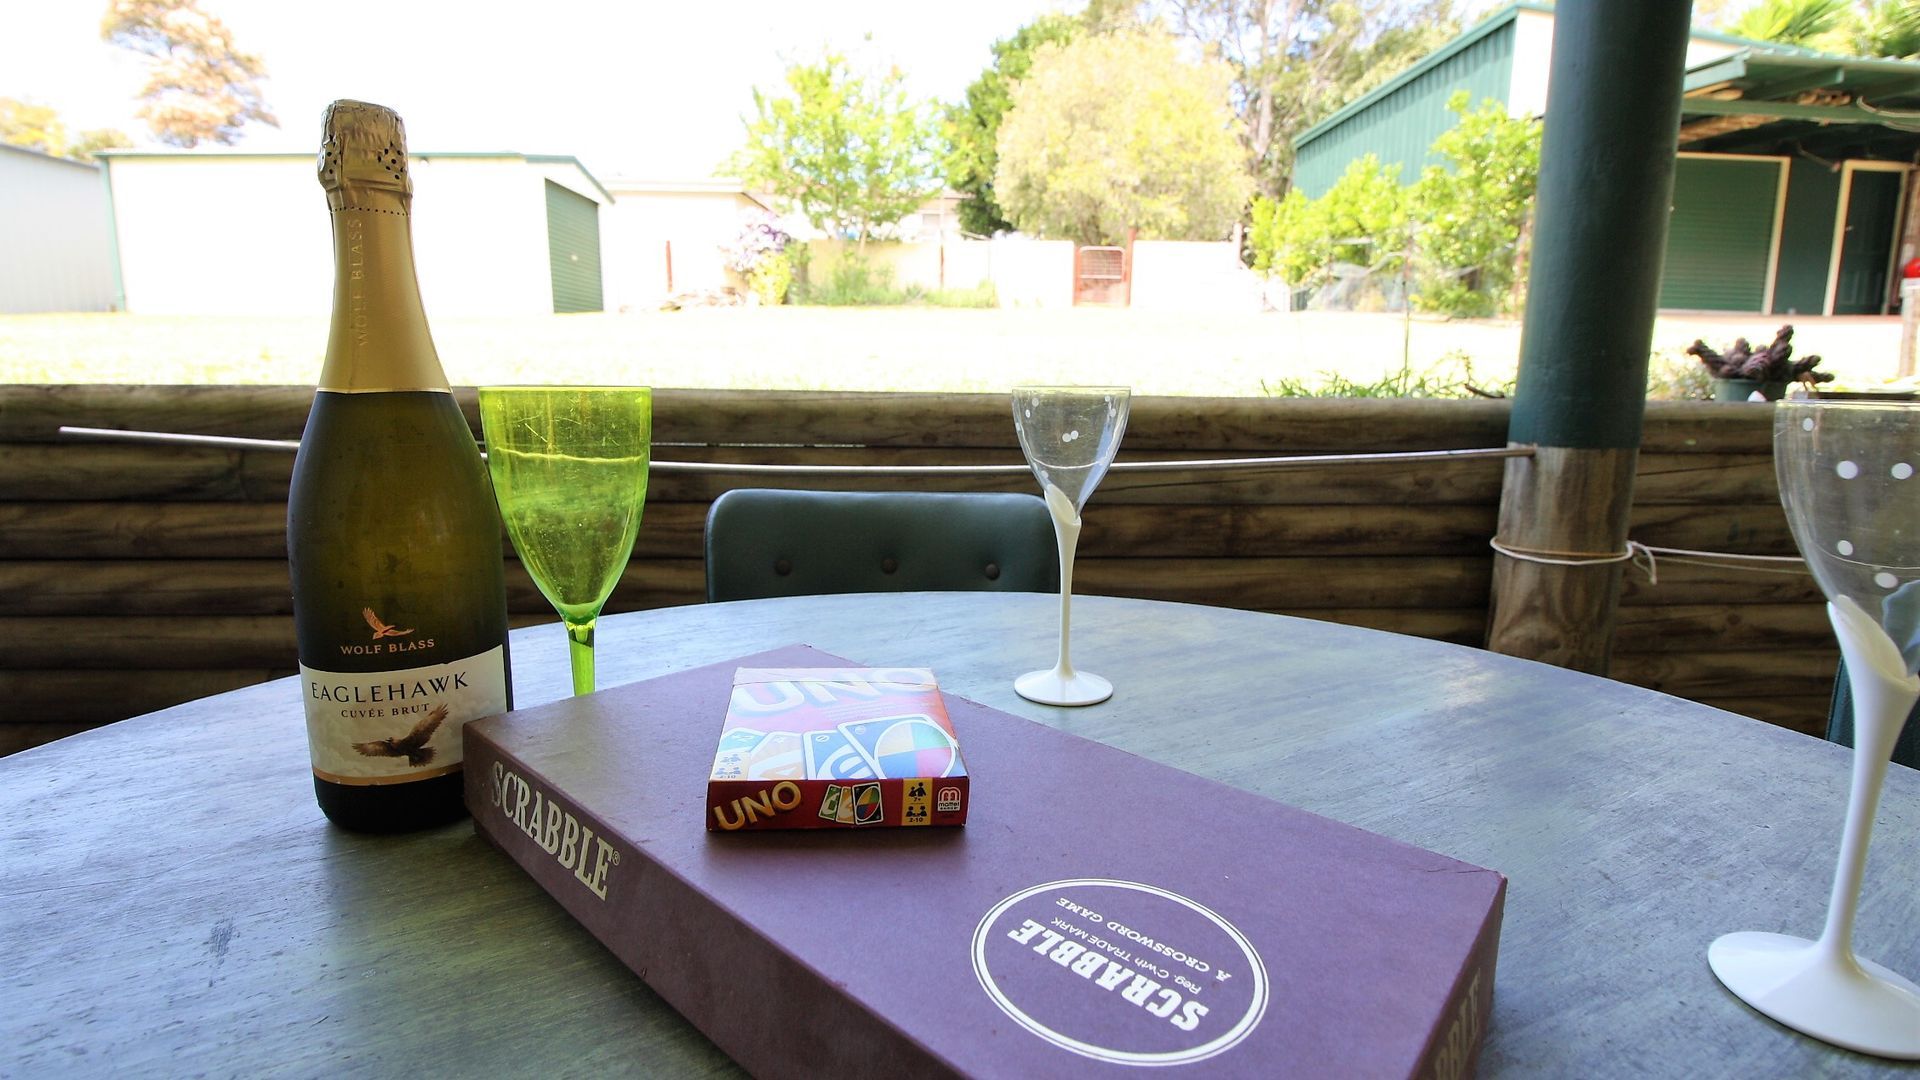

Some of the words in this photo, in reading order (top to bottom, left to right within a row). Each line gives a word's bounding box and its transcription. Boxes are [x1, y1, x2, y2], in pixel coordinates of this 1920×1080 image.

[350, 218, 364, 280] BLASS
[340, 644, 382, 655] WOLF
[389, 638, 435, 653] BLASS
[311, 671, 469, 703] EAGLEHAWK
[736, 667, 939, 712] UNO
[341, 707, 385, 719] CUVÉE
[392, 703, 430, 716] BRUT
[714, 781, 801, 831] UNO
[1055, 897, 1103, 923] GAME
[1050, 916, 1088, 937] MARK
[1088, 936, 1131, 962] TRADE
[1106, 921, 1210, 973] CROSSWORD
[1006, 918, 1210, 1031] SCRABBLE
[1173, 974, 1202, 995] Reg.
[1215, 969, 1232, 982] A
